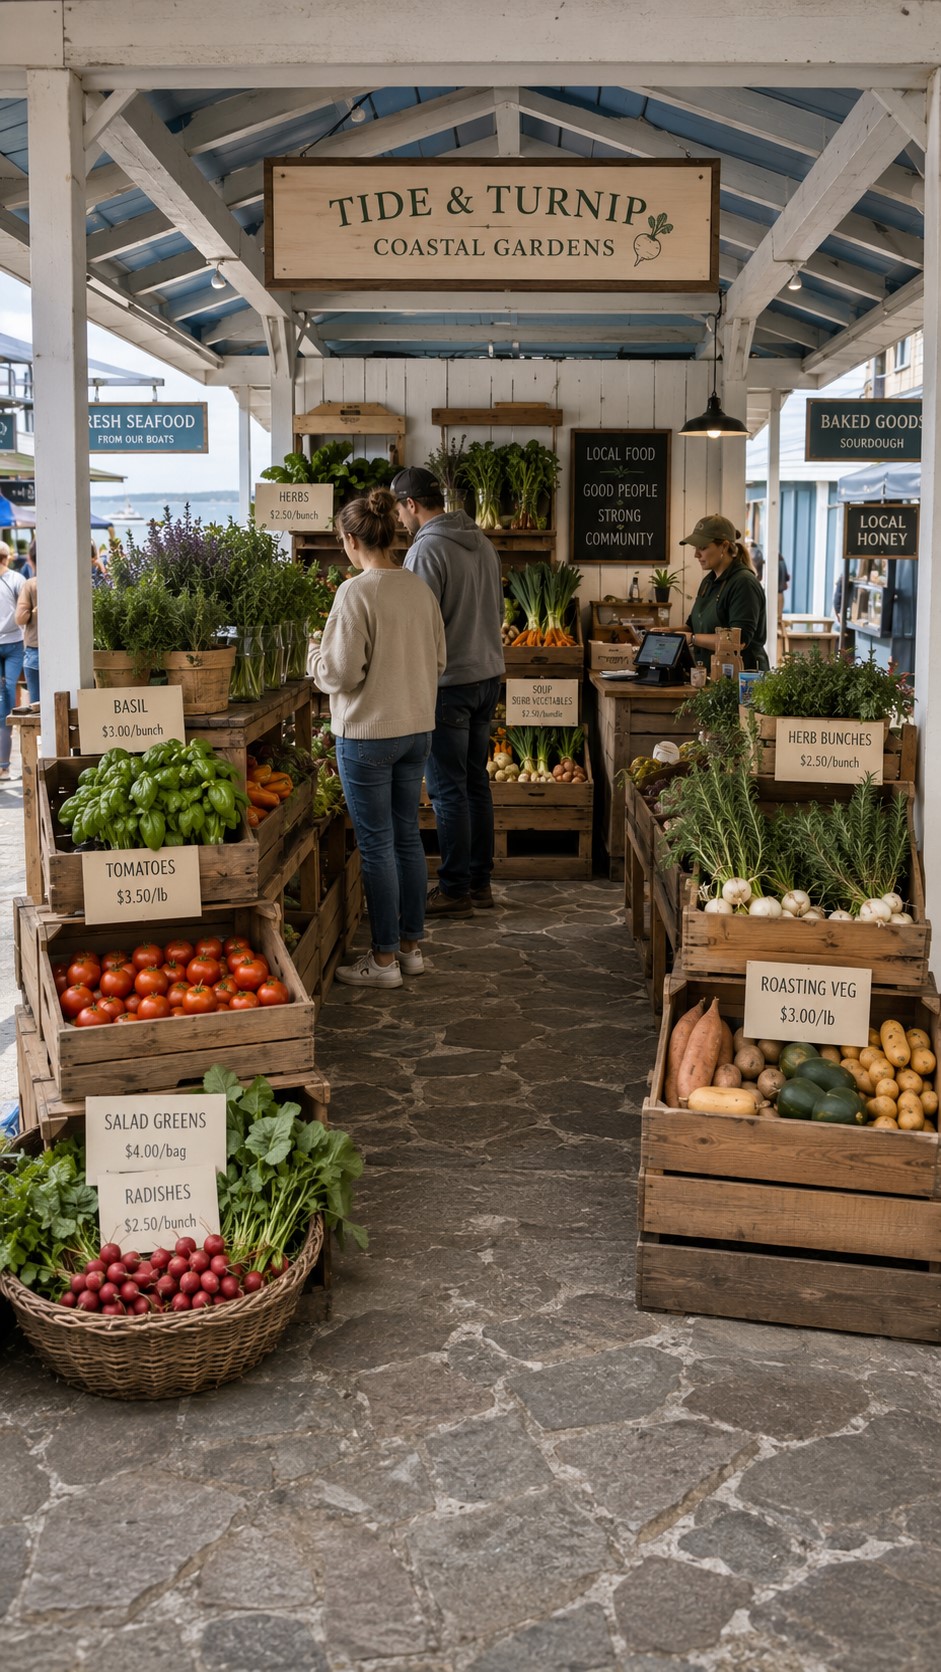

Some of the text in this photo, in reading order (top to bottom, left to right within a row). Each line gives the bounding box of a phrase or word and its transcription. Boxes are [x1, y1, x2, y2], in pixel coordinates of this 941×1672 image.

[328, 184, 649, 229] TIDE & TURNIP
[373, 237, 615, 258] COASTAL GARDENS
[88, 414, 195, 429] RESH SEAFOOD
[821, 414, 870, 429] BAKED
[97, 435, 175, 444] FROM OUR BOATS
[840, 437, 904, 449] SOURDOUGH
[586, 446, 656, 461] LOCAL FOOD
[279, 490, 309, 503] HERBS
[583, 482, 658, 497] GOOD PEOPLE
[270, 509, 318, 522] $2.50/bunch
[598, 508, 641, 523] STRONG
[860, 515, 906, 529] LOCAL
[585, 531, 654, 546] COMMUNITY
[857, 532, 908, 546] HONEY
[532, 685, 553, 694] SOUP
[113, 698, 149, 714] BASIL
[102, 723, 164, 740] $3.00/bunch
[788, 730, 872, 747] HERB BUNCHES
[800, 754, 860, 769] $2.50/bunch
[106, 858, 176, 878] TOMATOES
[116, 886, 168, 906] $3.50/lb
[761, 975, 857, 998] ROASTING VEG
[779, 1005, 835, 1026] $3.00/lb
[104, 1112, 207, 1131] SALAD GREENS
[125, 1143, 187, 1161] $4.00/bag
[125, 1183, 191, 1205] RADISHES
[124, 1213, 197, 1234] $2.50/bunch
